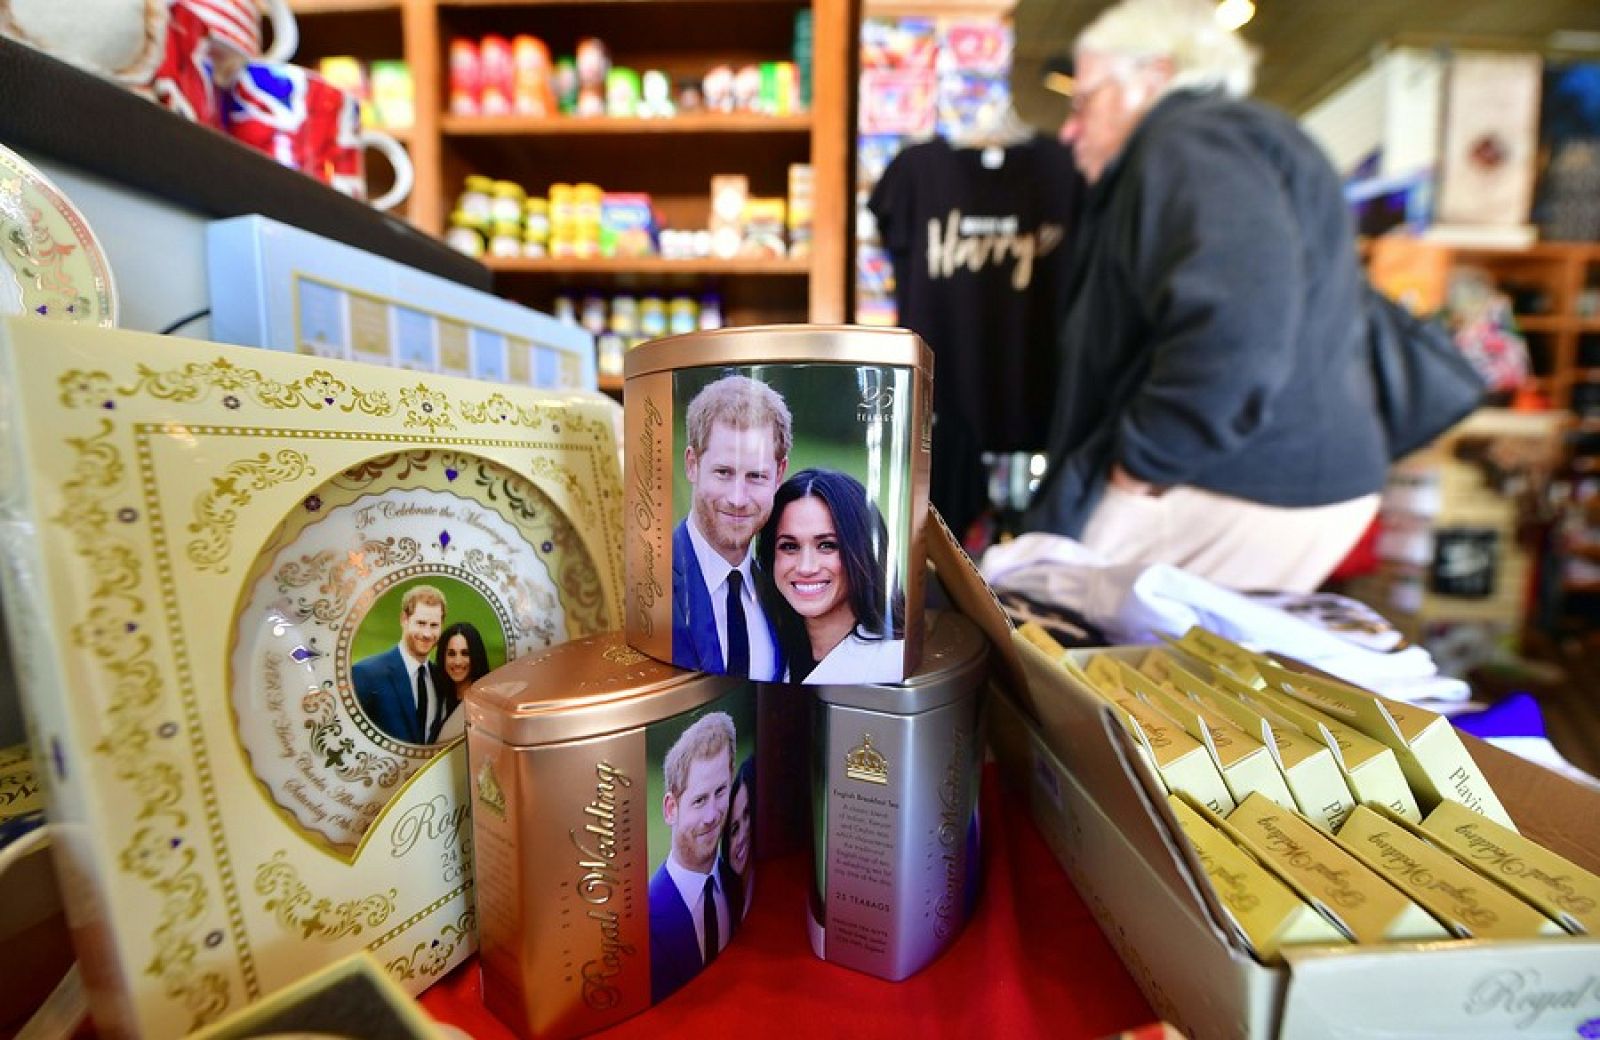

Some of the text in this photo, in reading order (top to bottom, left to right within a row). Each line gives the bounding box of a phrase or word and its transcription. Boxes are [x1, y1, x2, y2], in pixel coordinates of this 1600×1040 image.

[928, 208, 1034, 290] Harry
[633, 396, 664, 531] Wedding
[377, 500, 438, 520] Celebrate
[391, 794, 470, 858] Roy
[1454, 823, 1525, 876] Wedding
[570, 760, 637, 1011] Royal Wedding
[1367, 831, 1433, 887] Wedding
[1462, 966, 1599, 1031] Royal
